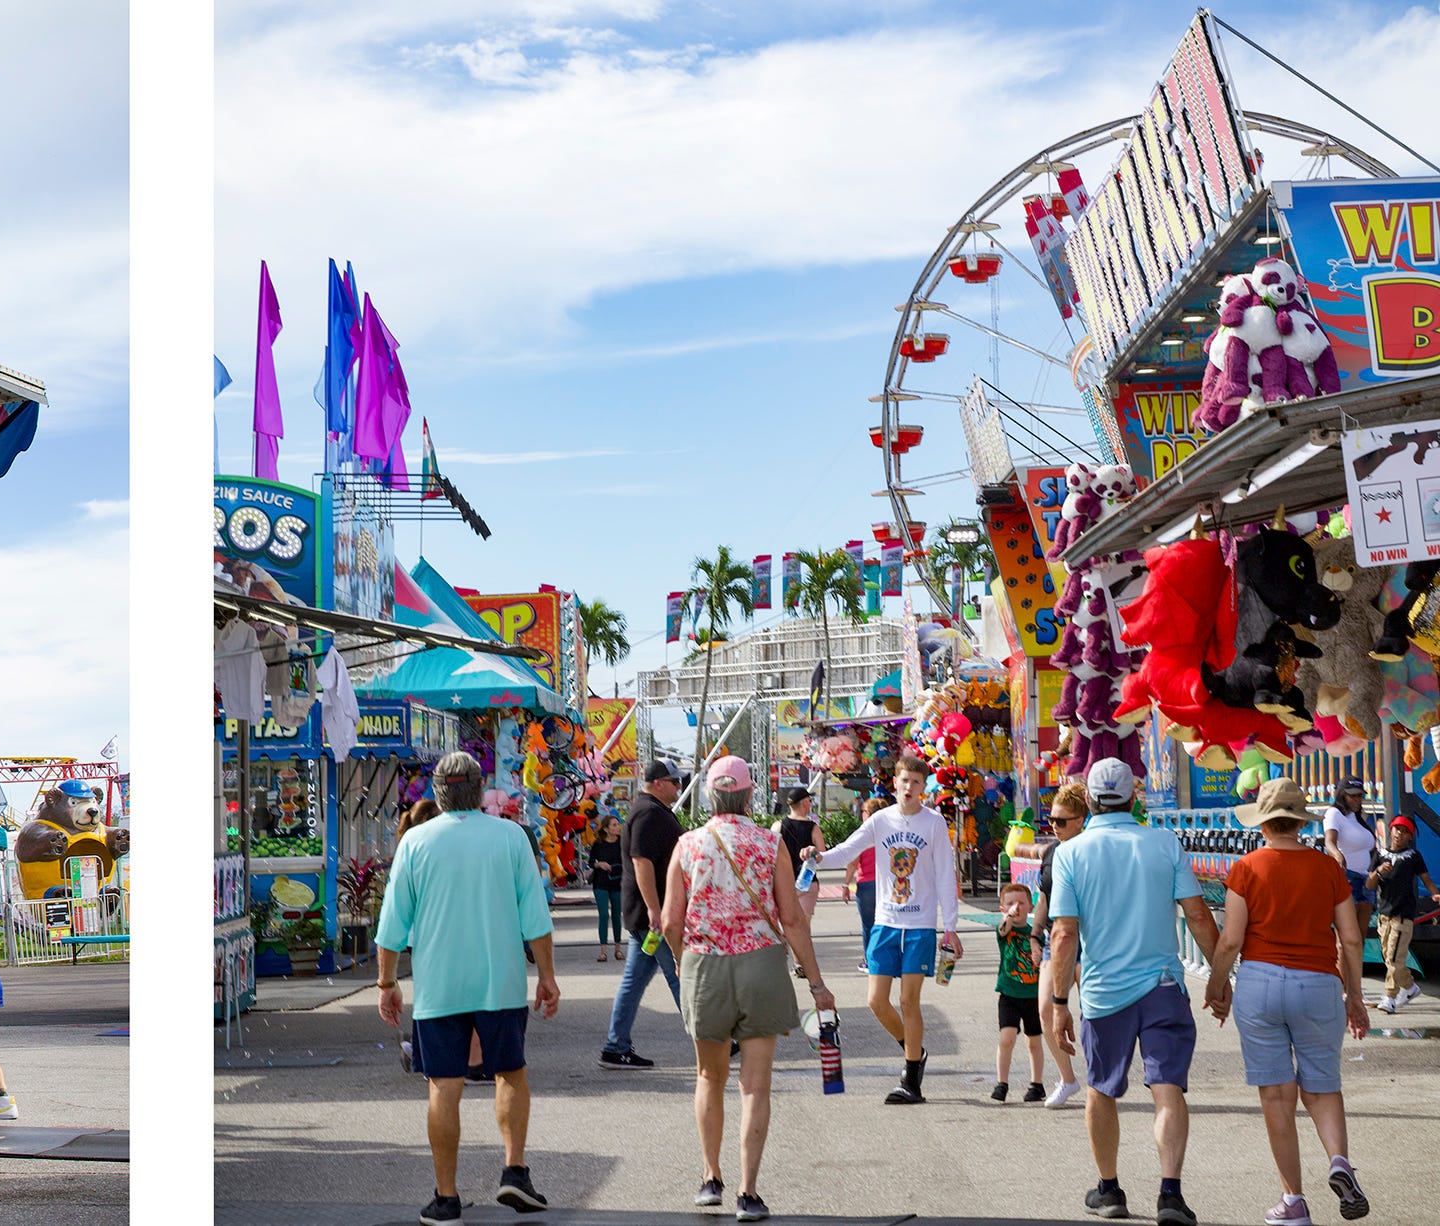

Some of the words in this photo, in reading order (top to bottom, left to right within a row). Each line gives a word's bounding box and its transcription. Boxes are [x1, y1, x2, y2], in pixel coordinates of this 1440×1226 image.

[1331, 201, 1440, 266] WI
[242, 487, 294, 510] SAUCE
[1370, 551, 1385, 562] NO
[1386, 548, 1408, 561] WIN
[1426, 543, 1440, 557] WI
[225, 717, 298, 739] PTAS
[307, 759, 317, 839] PINCHOS
[886, 832, 905, 846] HAVE
[905, 832, 928, 850] HEART
